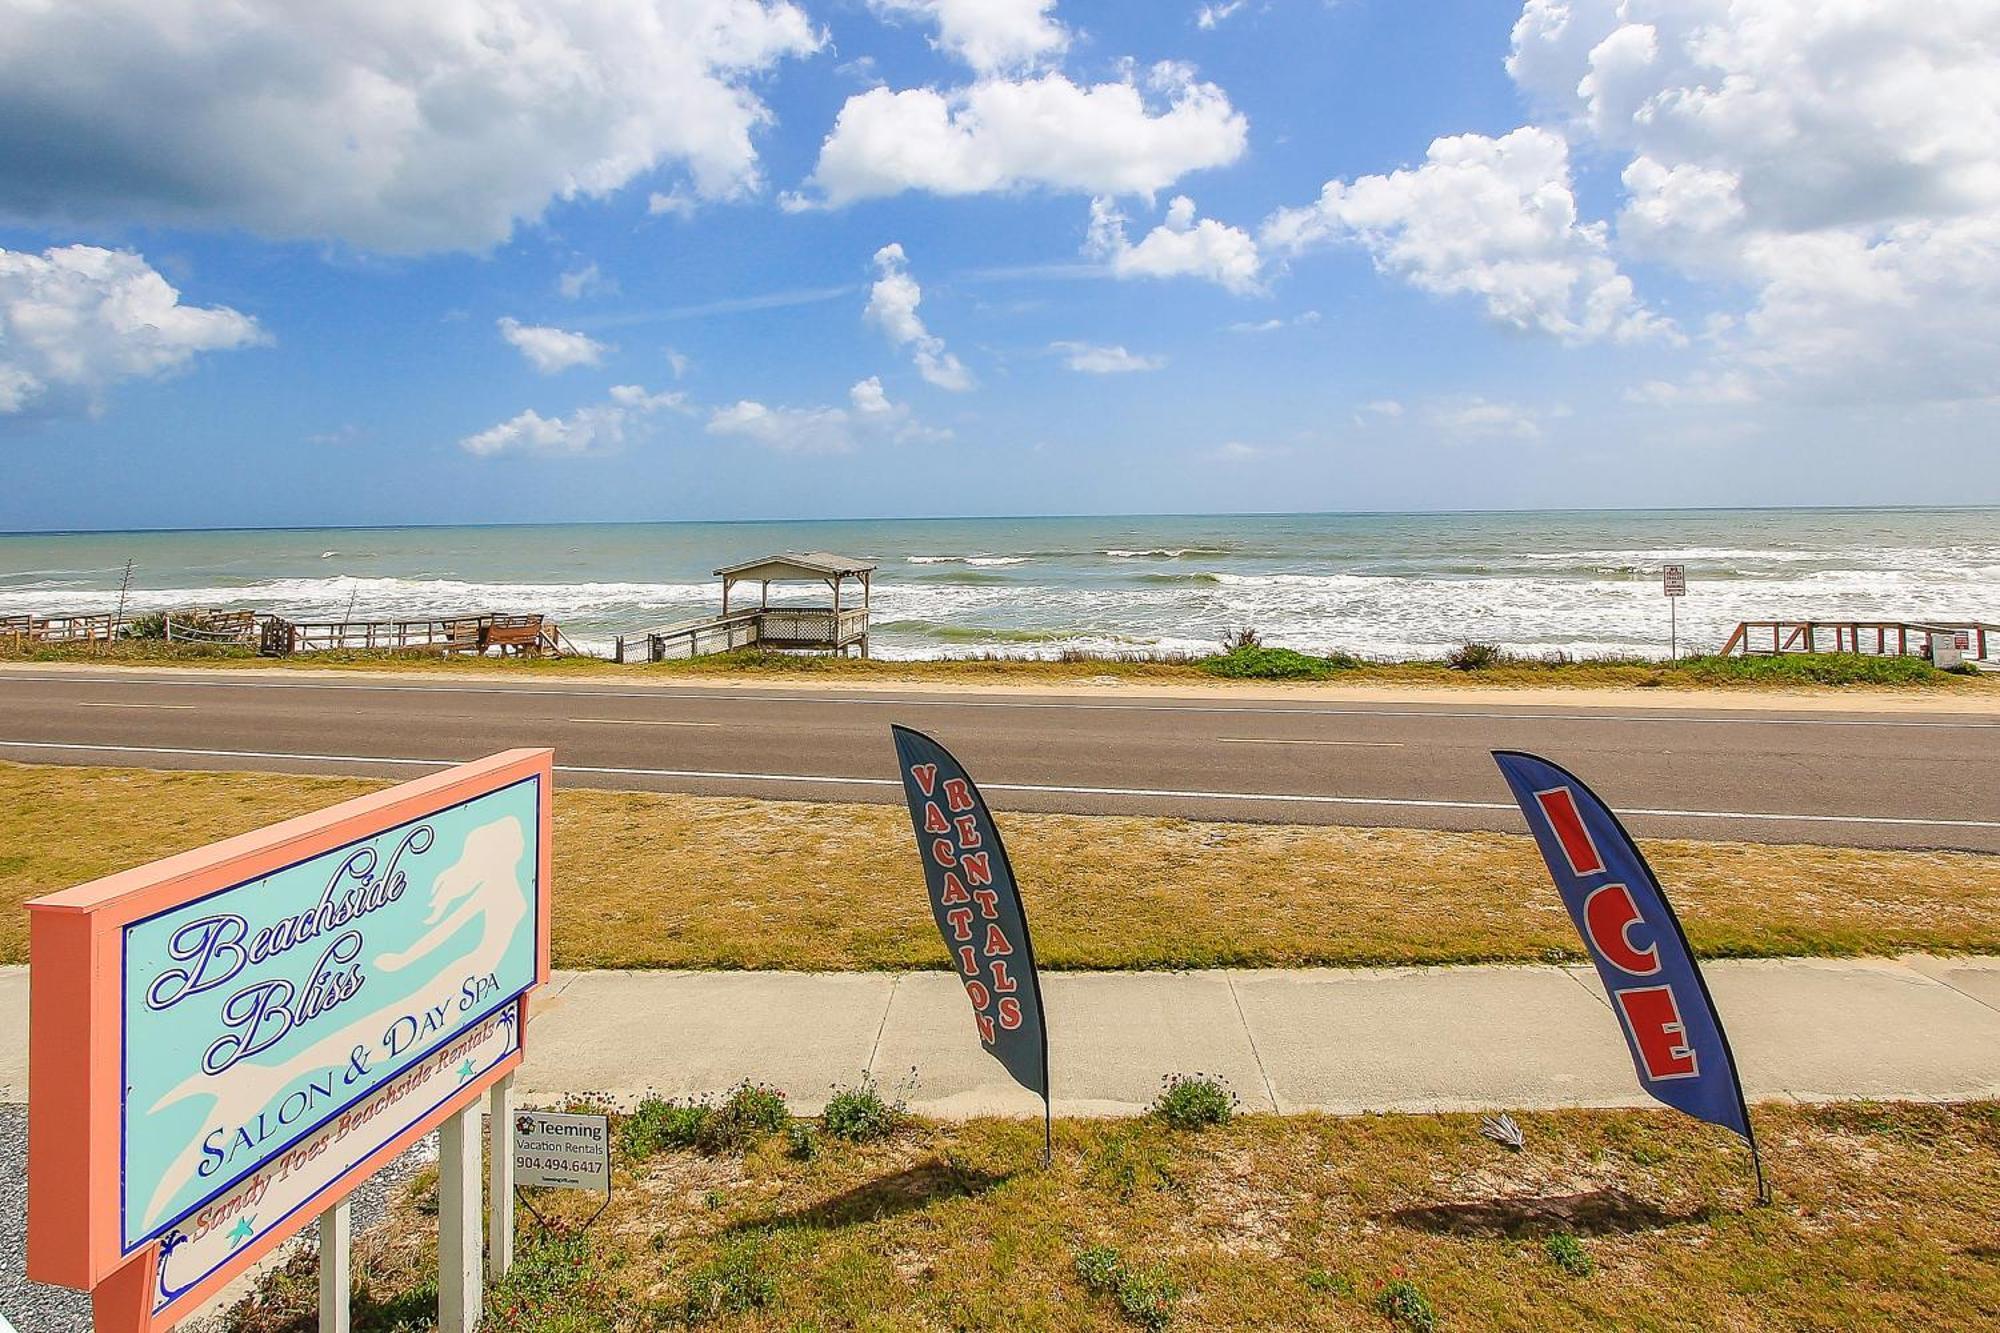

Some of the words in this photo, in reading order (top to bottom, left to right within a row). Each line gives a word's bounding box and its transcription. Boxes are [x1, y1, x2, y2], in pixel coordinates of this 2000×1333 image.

[146, 824, 435, 1011] Beachside
[911, 763, 995, 1045] VACATION
[943, 776, 1023, 1030] RENTALS
[1533, 785, 1700, 1082] ICE
[201, 930, 366, 1076] Bliss
[343, 1044, 373, 1085] &
[192, 1174, 274, 1244] Sandy
[278, 1132, 330, 1183] Toes
[334, 1068, 433, 1145] Beachside
[435, 1021, 497, 1075] Rentals
[516, 1156, 603, 1174] 904.494.6417
[517, 1139, 562, 1152] Vacation
[565, 1142, 604, 1155] Rentals
[538, 1120, 603, 1141] Teeming
